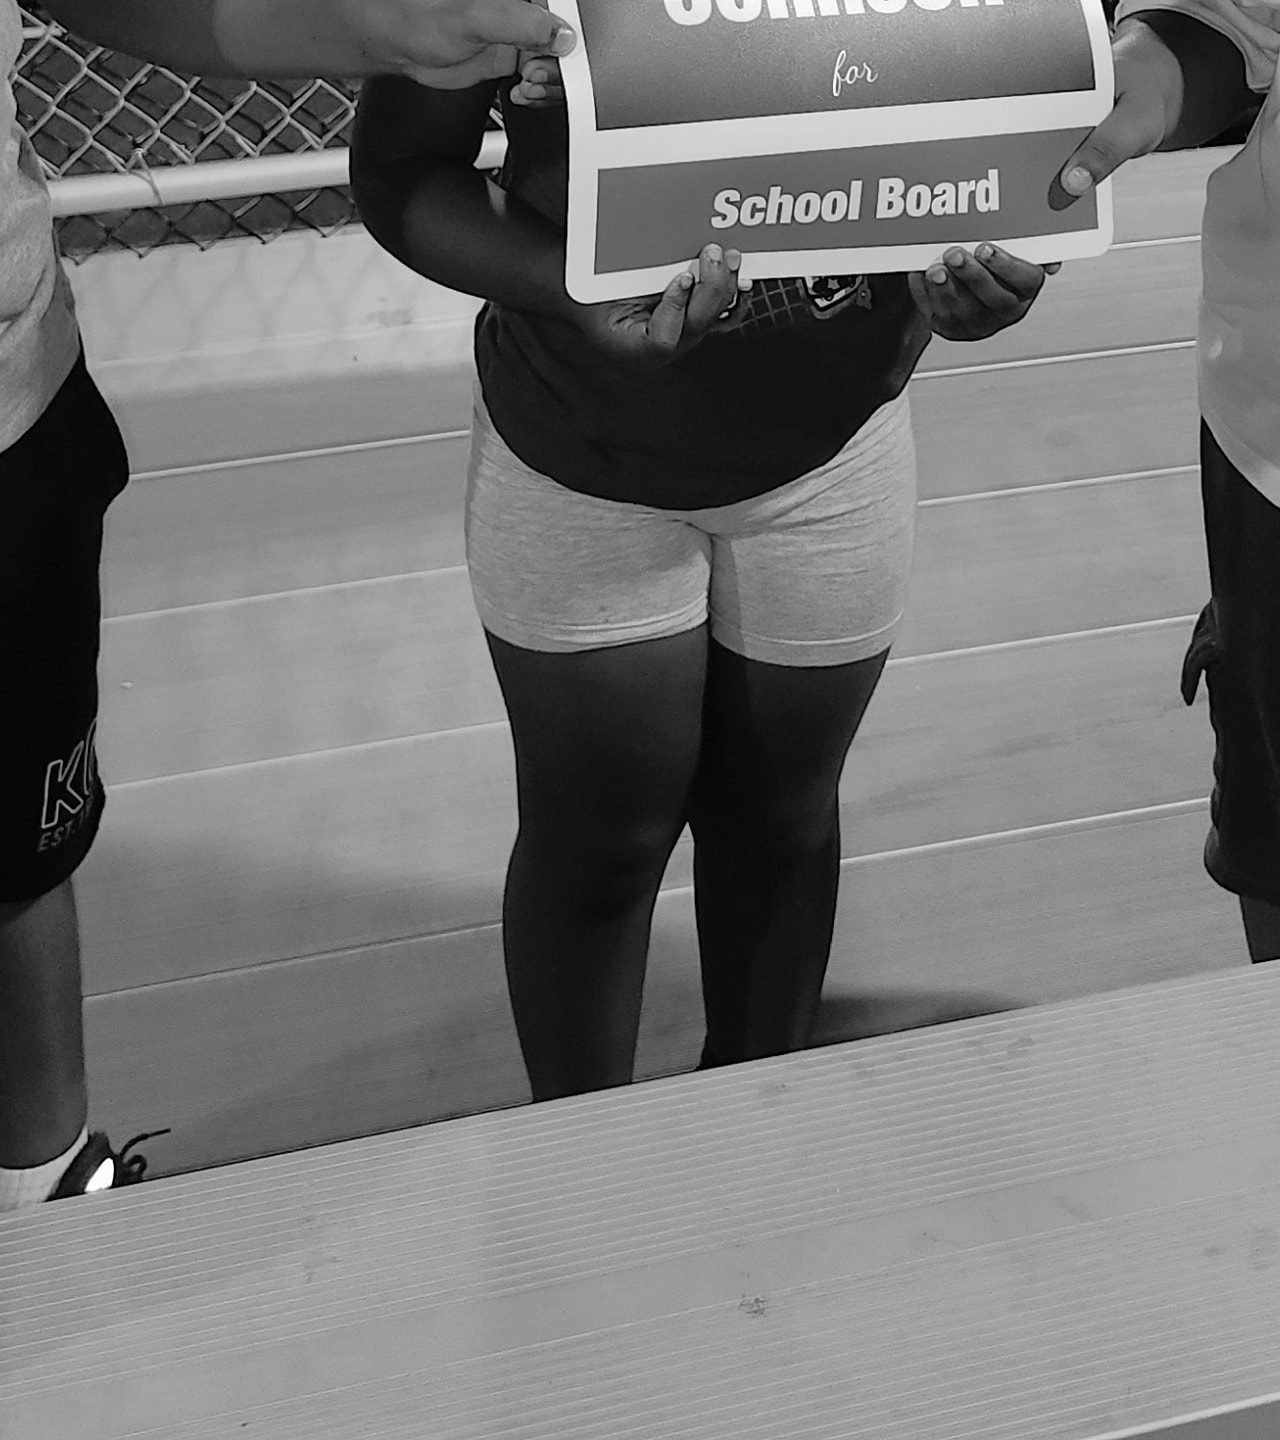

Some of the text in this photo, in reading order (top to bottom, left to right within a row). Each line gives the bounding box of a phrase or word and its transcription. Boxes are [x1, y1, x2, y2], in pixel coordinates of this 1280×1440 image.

[832, 50, 878, 96] for
[710, 169, 1000, 228] School Board
